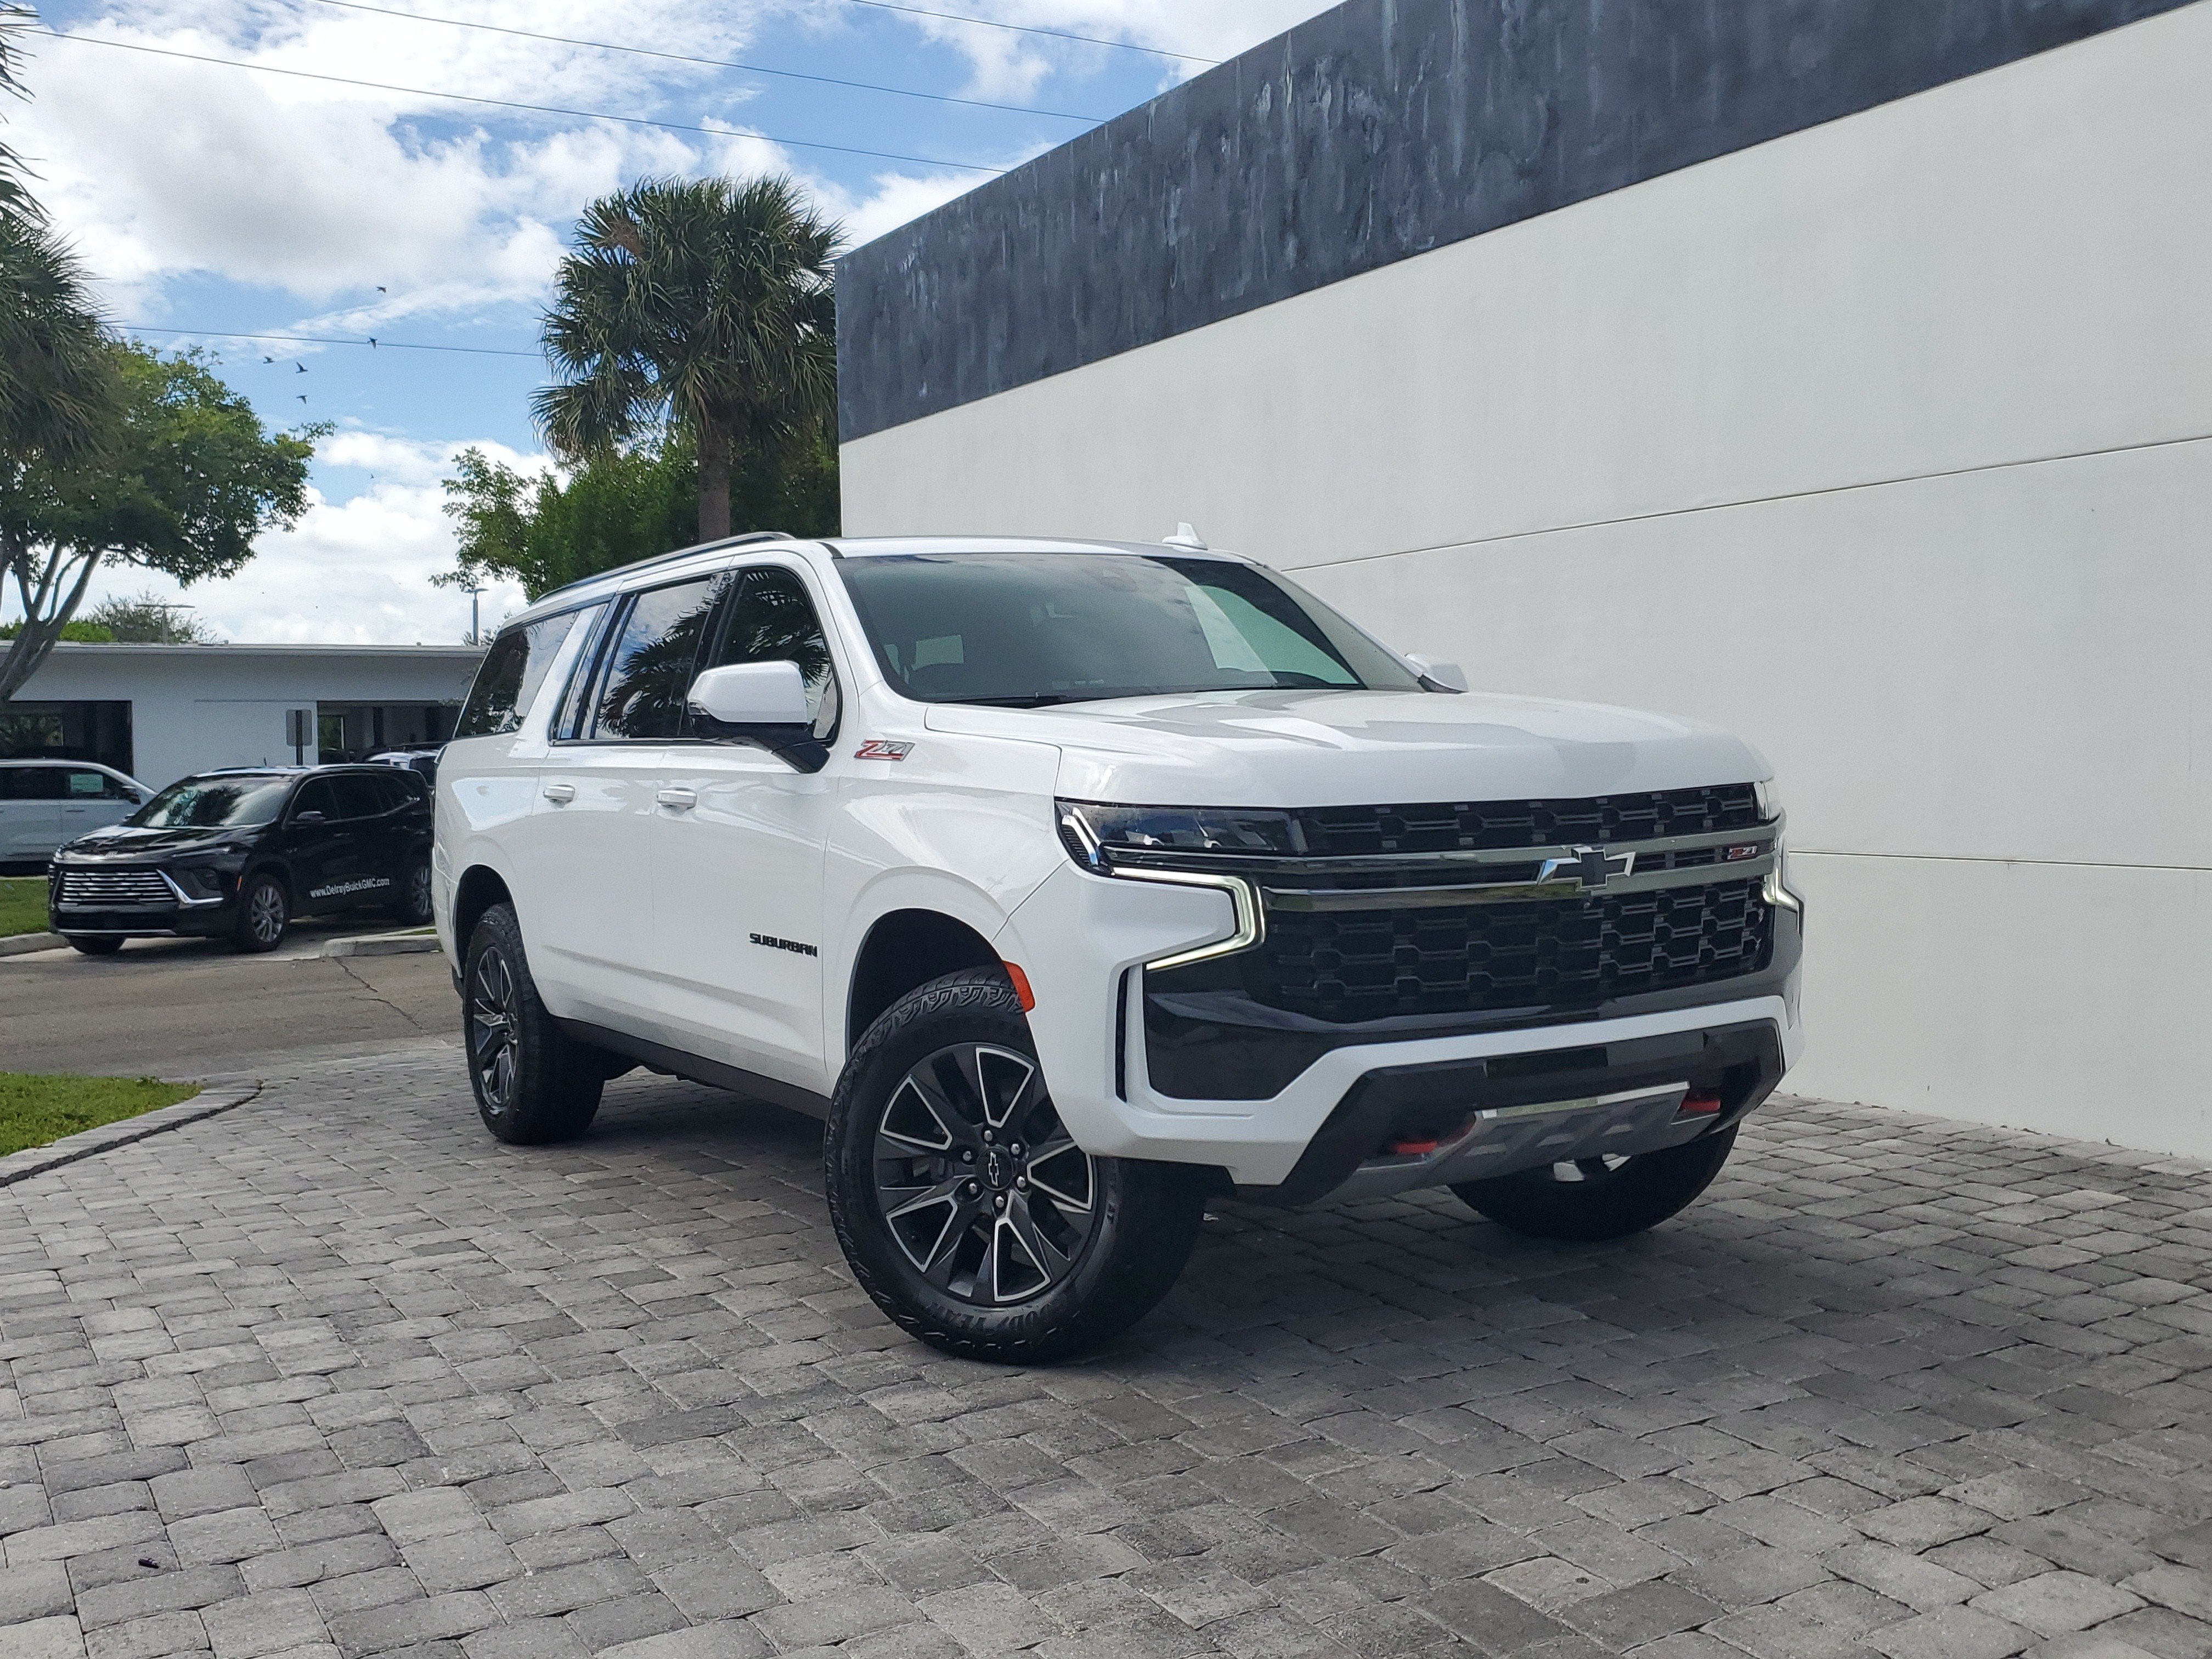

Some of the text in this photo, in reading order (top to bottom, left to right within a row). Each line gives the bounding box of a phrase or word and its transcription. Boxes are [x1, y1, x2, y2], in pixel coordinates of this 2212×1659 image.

[854, 739, 916, 761] Z71
[1727, 845, 1758, 860] Z71
[309, 878, 390, 898] www.DelrayBuickGMC.com
[749, 932, 818, 958] SUBURBAN
